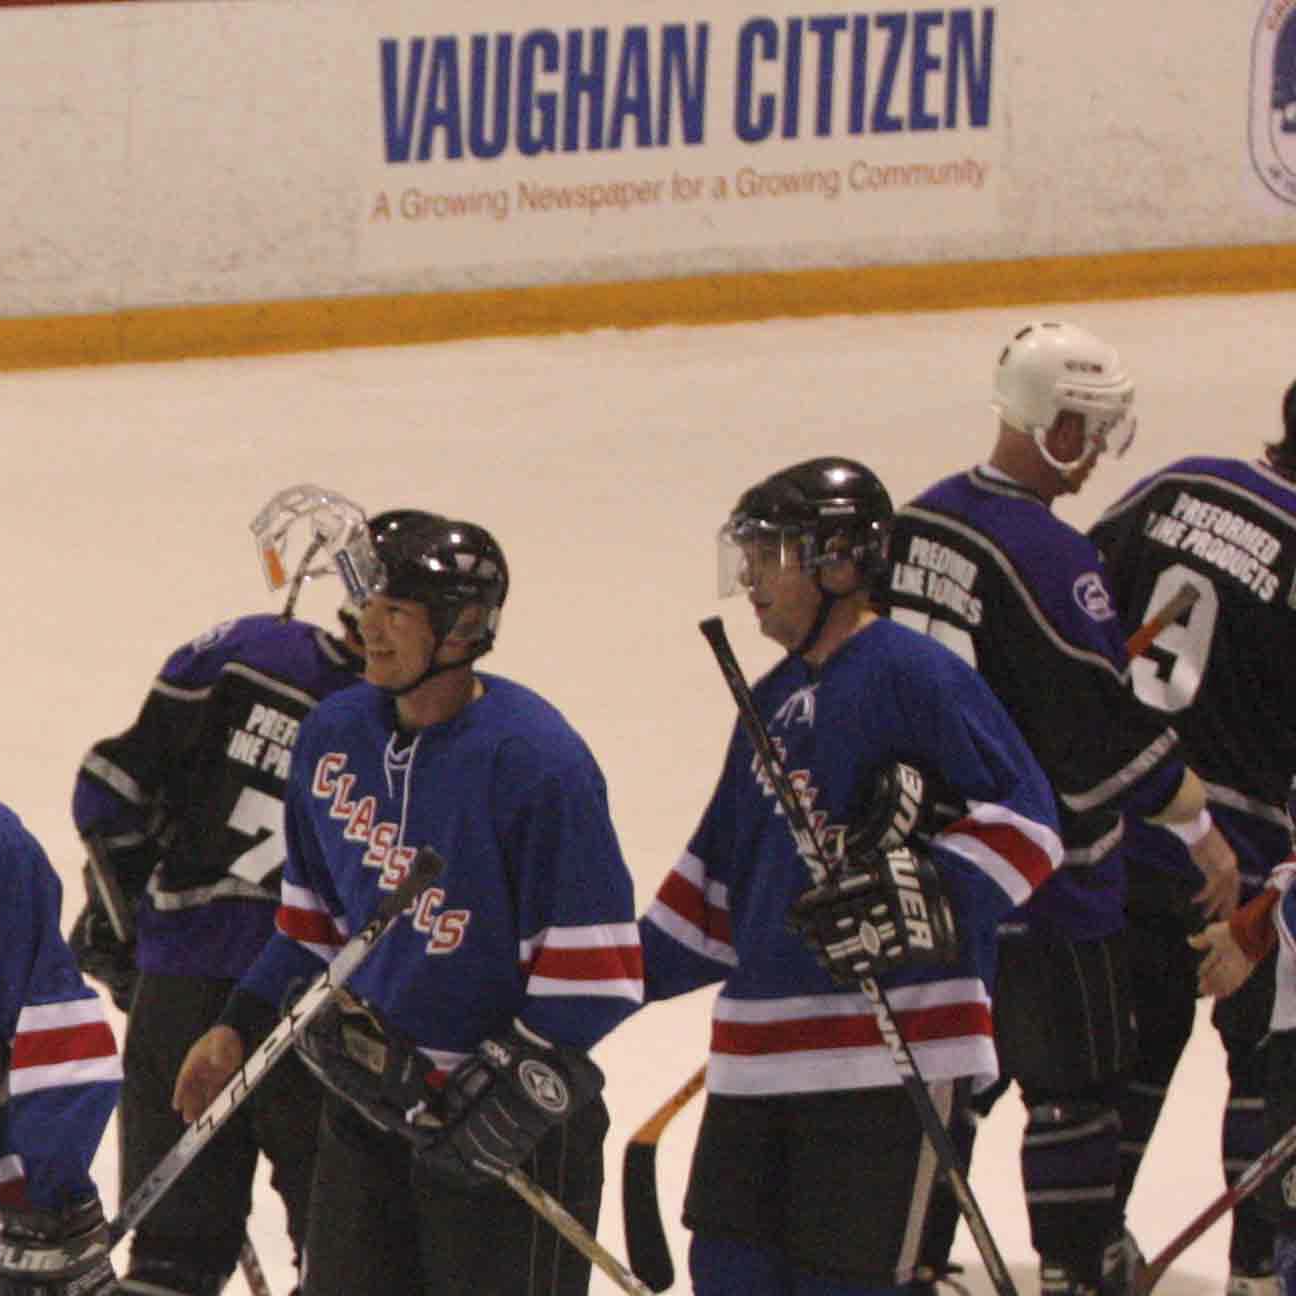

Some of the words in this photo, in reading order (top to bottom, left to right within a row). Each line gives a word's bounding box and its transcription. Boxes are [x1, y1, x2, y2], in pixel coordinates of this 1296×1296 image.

[379, 22, 710, 164] VAUGHAN
[733, 7, 994, 144] CITIZEN
[371, 192, 392, 224] A
[400, 188, 509, 223] Growing
[517, 178, 665, 216] Newspaper
[671, 170, 704, 200] for
[712, 176, 727, 201] a
[735, 167, 841, 200] Growing
[848, 159, 987, 191] Community
[1171, 490, 1282, 567] PREFORMED
[1180, 527, 1281, 604] PRODUCTS
[1130, 563, 1219, 713] 9
[227, 786, 288, 885] 7
[312, 752, 472, 956] CLASSCS
